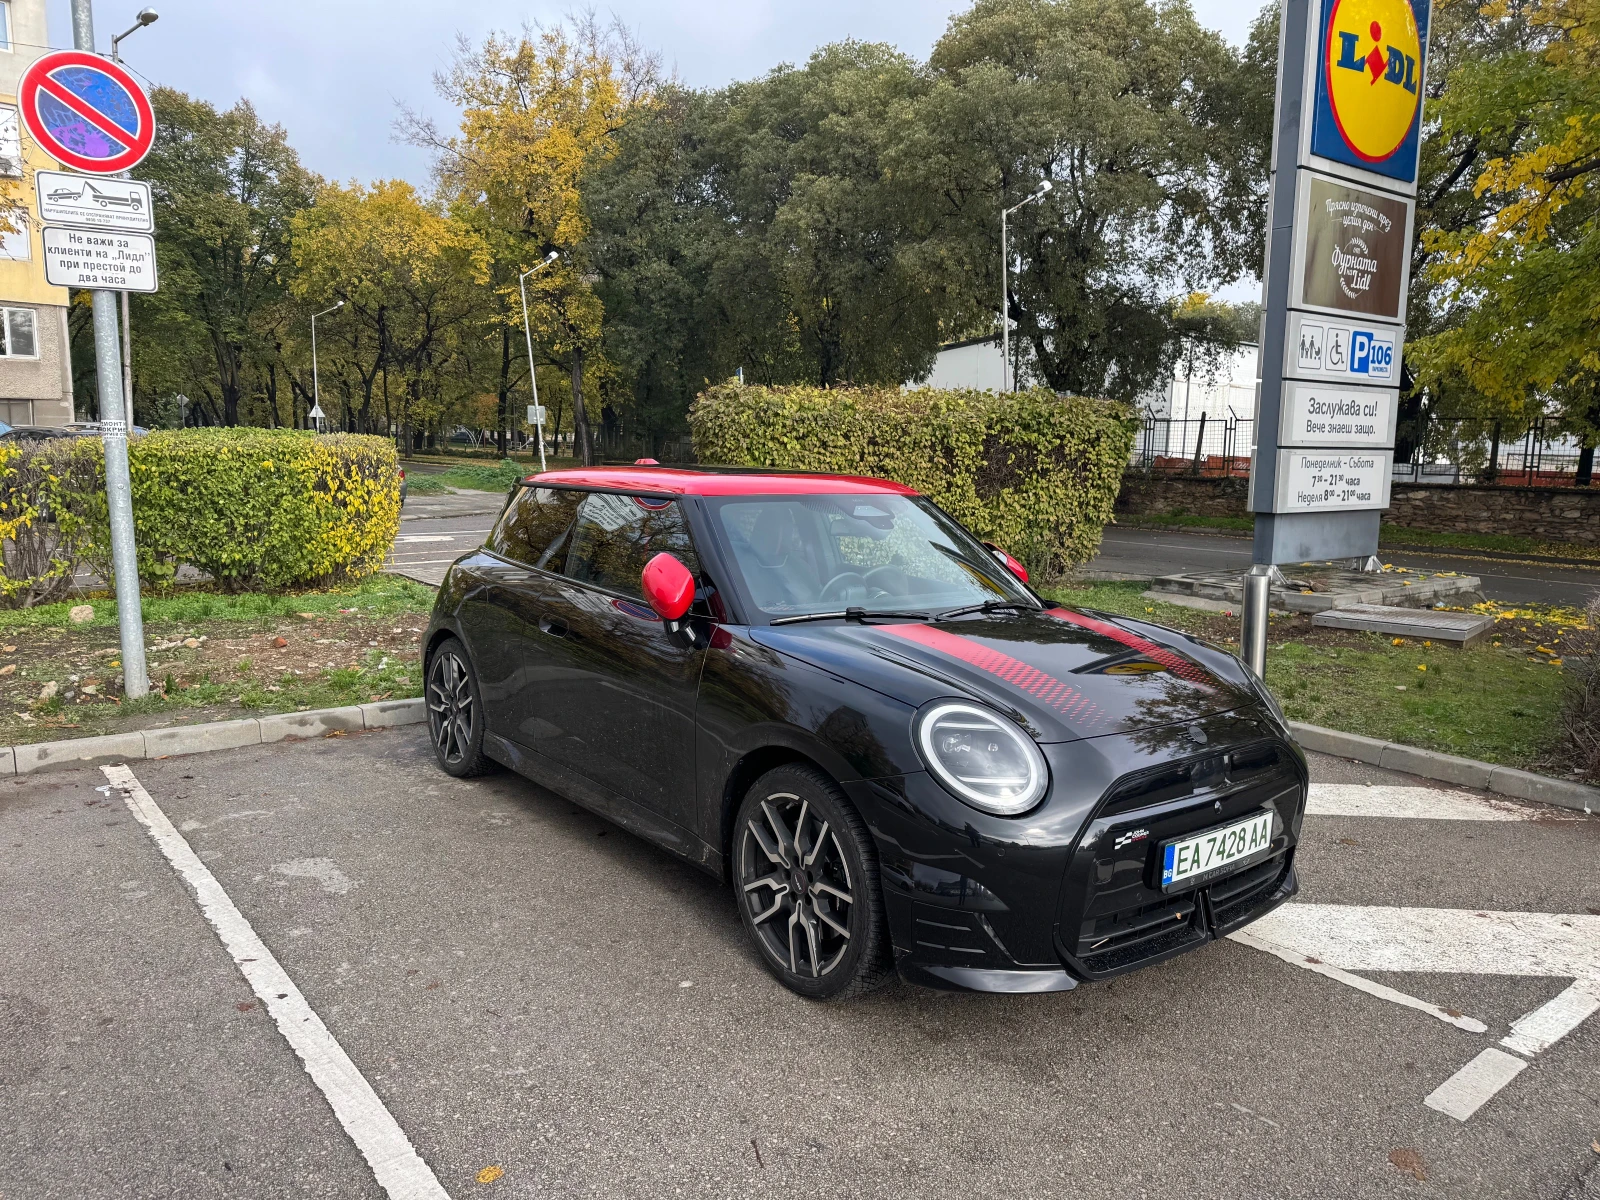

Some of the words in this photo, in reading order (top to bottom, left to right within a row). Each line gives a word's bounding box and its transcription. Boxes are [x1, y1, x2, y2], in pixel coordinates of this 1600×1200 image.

[1326, 198, 1350, 216] Прясно
[1378, 213, 1391, 232] през
[1362, 220, 1374, 233] ден
[69, 233, 82, 244] Не
[87, 236, 113, 247] важи
[48, 246, 92, 258] клиенти
[96, 250, 108, 258] на
[1332, 244, 1377, 275] Фурната
[60, 260, 80, 270] при
[83, 261, 125, 272] престой
[129, 265, 141, 274] до
[78, 274, 97, 283] два
[102, 276, 126, 284] часа
[1351, 270, 1371, 290] Lidl
[1354, 335, 1369, 369] P
[1370, 345, 1392, 365] 106
[1308, 397, 1360, 419] Заслужава
[1364, 400, 1378, 417] си!
[1306, 420, 1325, 433] Вече
[1328, 423, 1352, 434] знаеш
[1354, 424, 1375, 436] защо.
[1301, 457, 1341, 472] Понеделник
[1349, 457, 1374, 469] Събота
[1346, 477, 1360, 486] часа
[1298, 491, 1322, 505] Неделя
[1356, 492, 1371, 501] часа
[1176, 842, 1200, 876] EA
[1205, 828, 1246, 867] 7428
[1248, 818, 1267, 850] AA
[1163, 869, 1172, 878] BG
